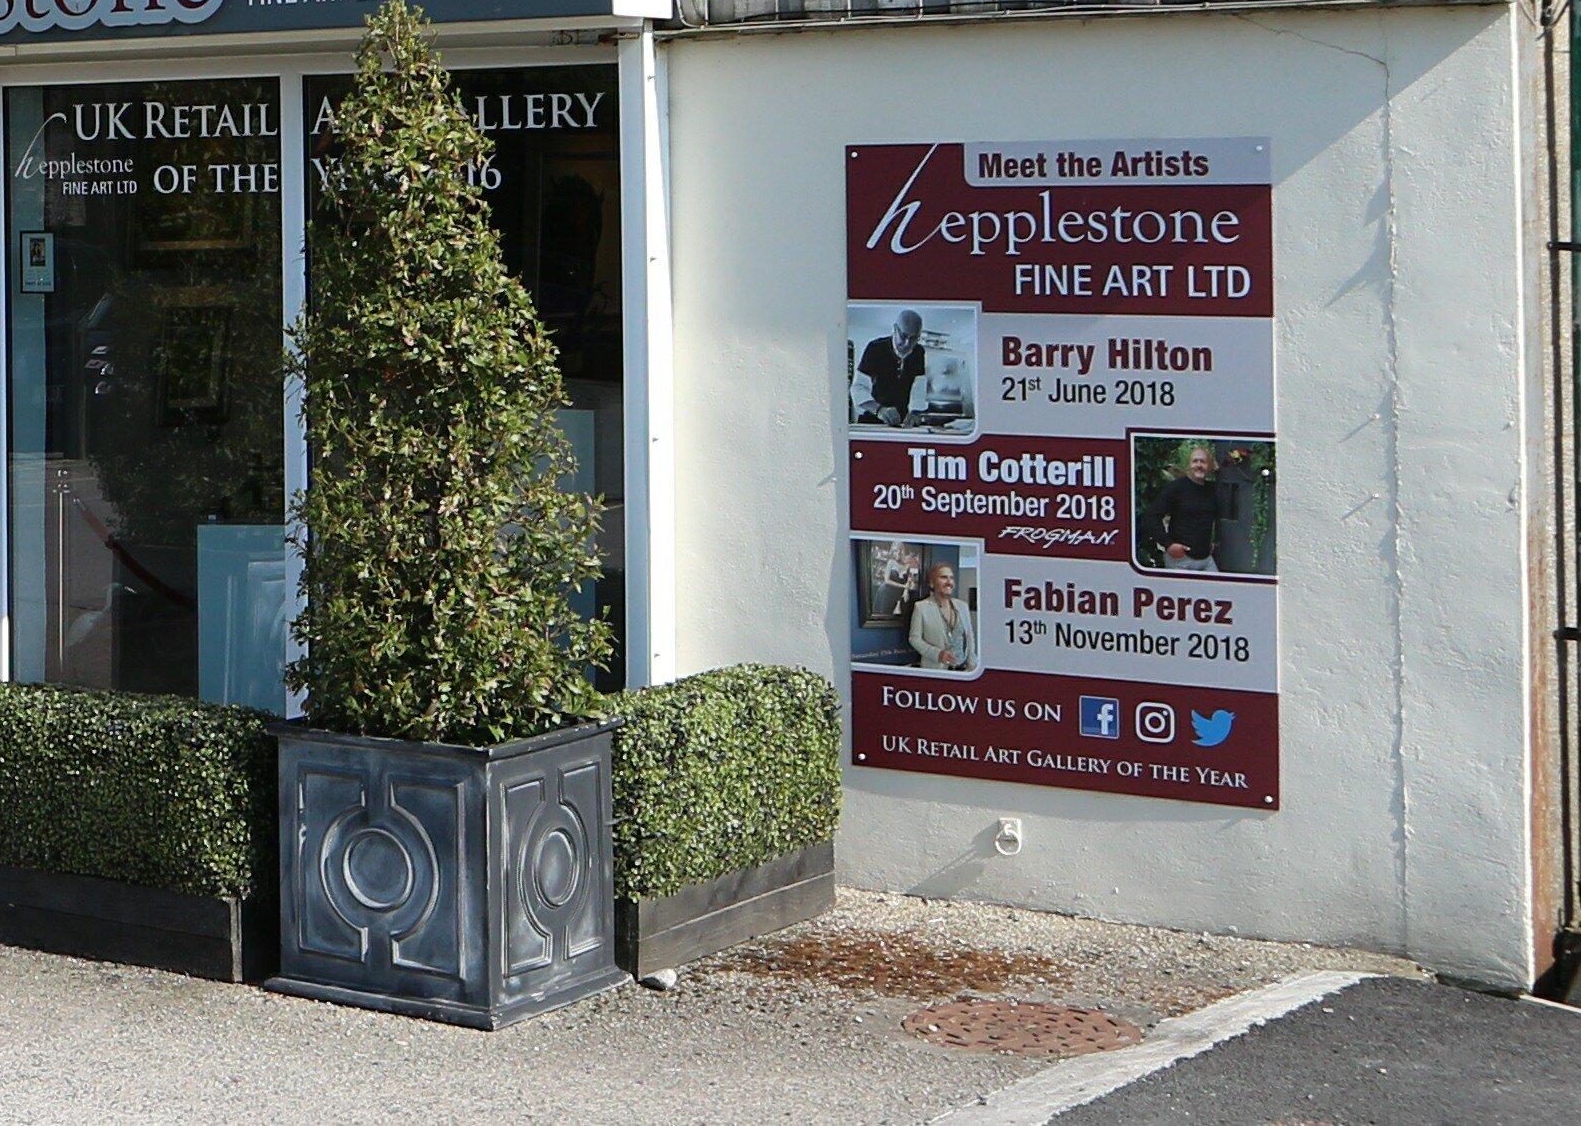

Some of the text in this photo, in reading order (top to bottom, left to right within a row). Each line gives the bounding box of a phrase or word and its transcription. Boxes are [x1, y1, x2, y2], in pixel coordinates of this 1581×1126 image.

[72, 102, 137, 142] UK
[144, 100, 279, 139] RETAIL
[461, 92, 606, 131] LLERY
[14, 112, 134, 180] hepplestone
[978, 149, 1210, 179] Meet the Artists
[62, 180, 137, 196] FINE ART LTD
[153, 165, 197, 195] OF
[208, 163, 279, 193] THE
[866, 143, 1241, 256] hepplestone
[1015, 264, 1252, 299] FINE ART LTD
[1001, 336, 1213, 376] Barry Hilton
[1001, 376, 1176, 407] 21st June 2018
[907, 448, 1116, 489] Tim Cotterill
[873, 484, 1116, 522] 20th September 2018
[999, 525, 1120, 549] FROGMAN
[1004, 578, 1233, 625] Fabian Perez
[1004, 619, 1251, 662] 13th November 2018
[882, 685, 979, 716] FOLLOW
[986, 698, 1017, 719] US
[1024, 700, 1062, 722] ON
[882, 734, 1249, 790] UK RETAIL ART GALLERY OF THE YEAR
